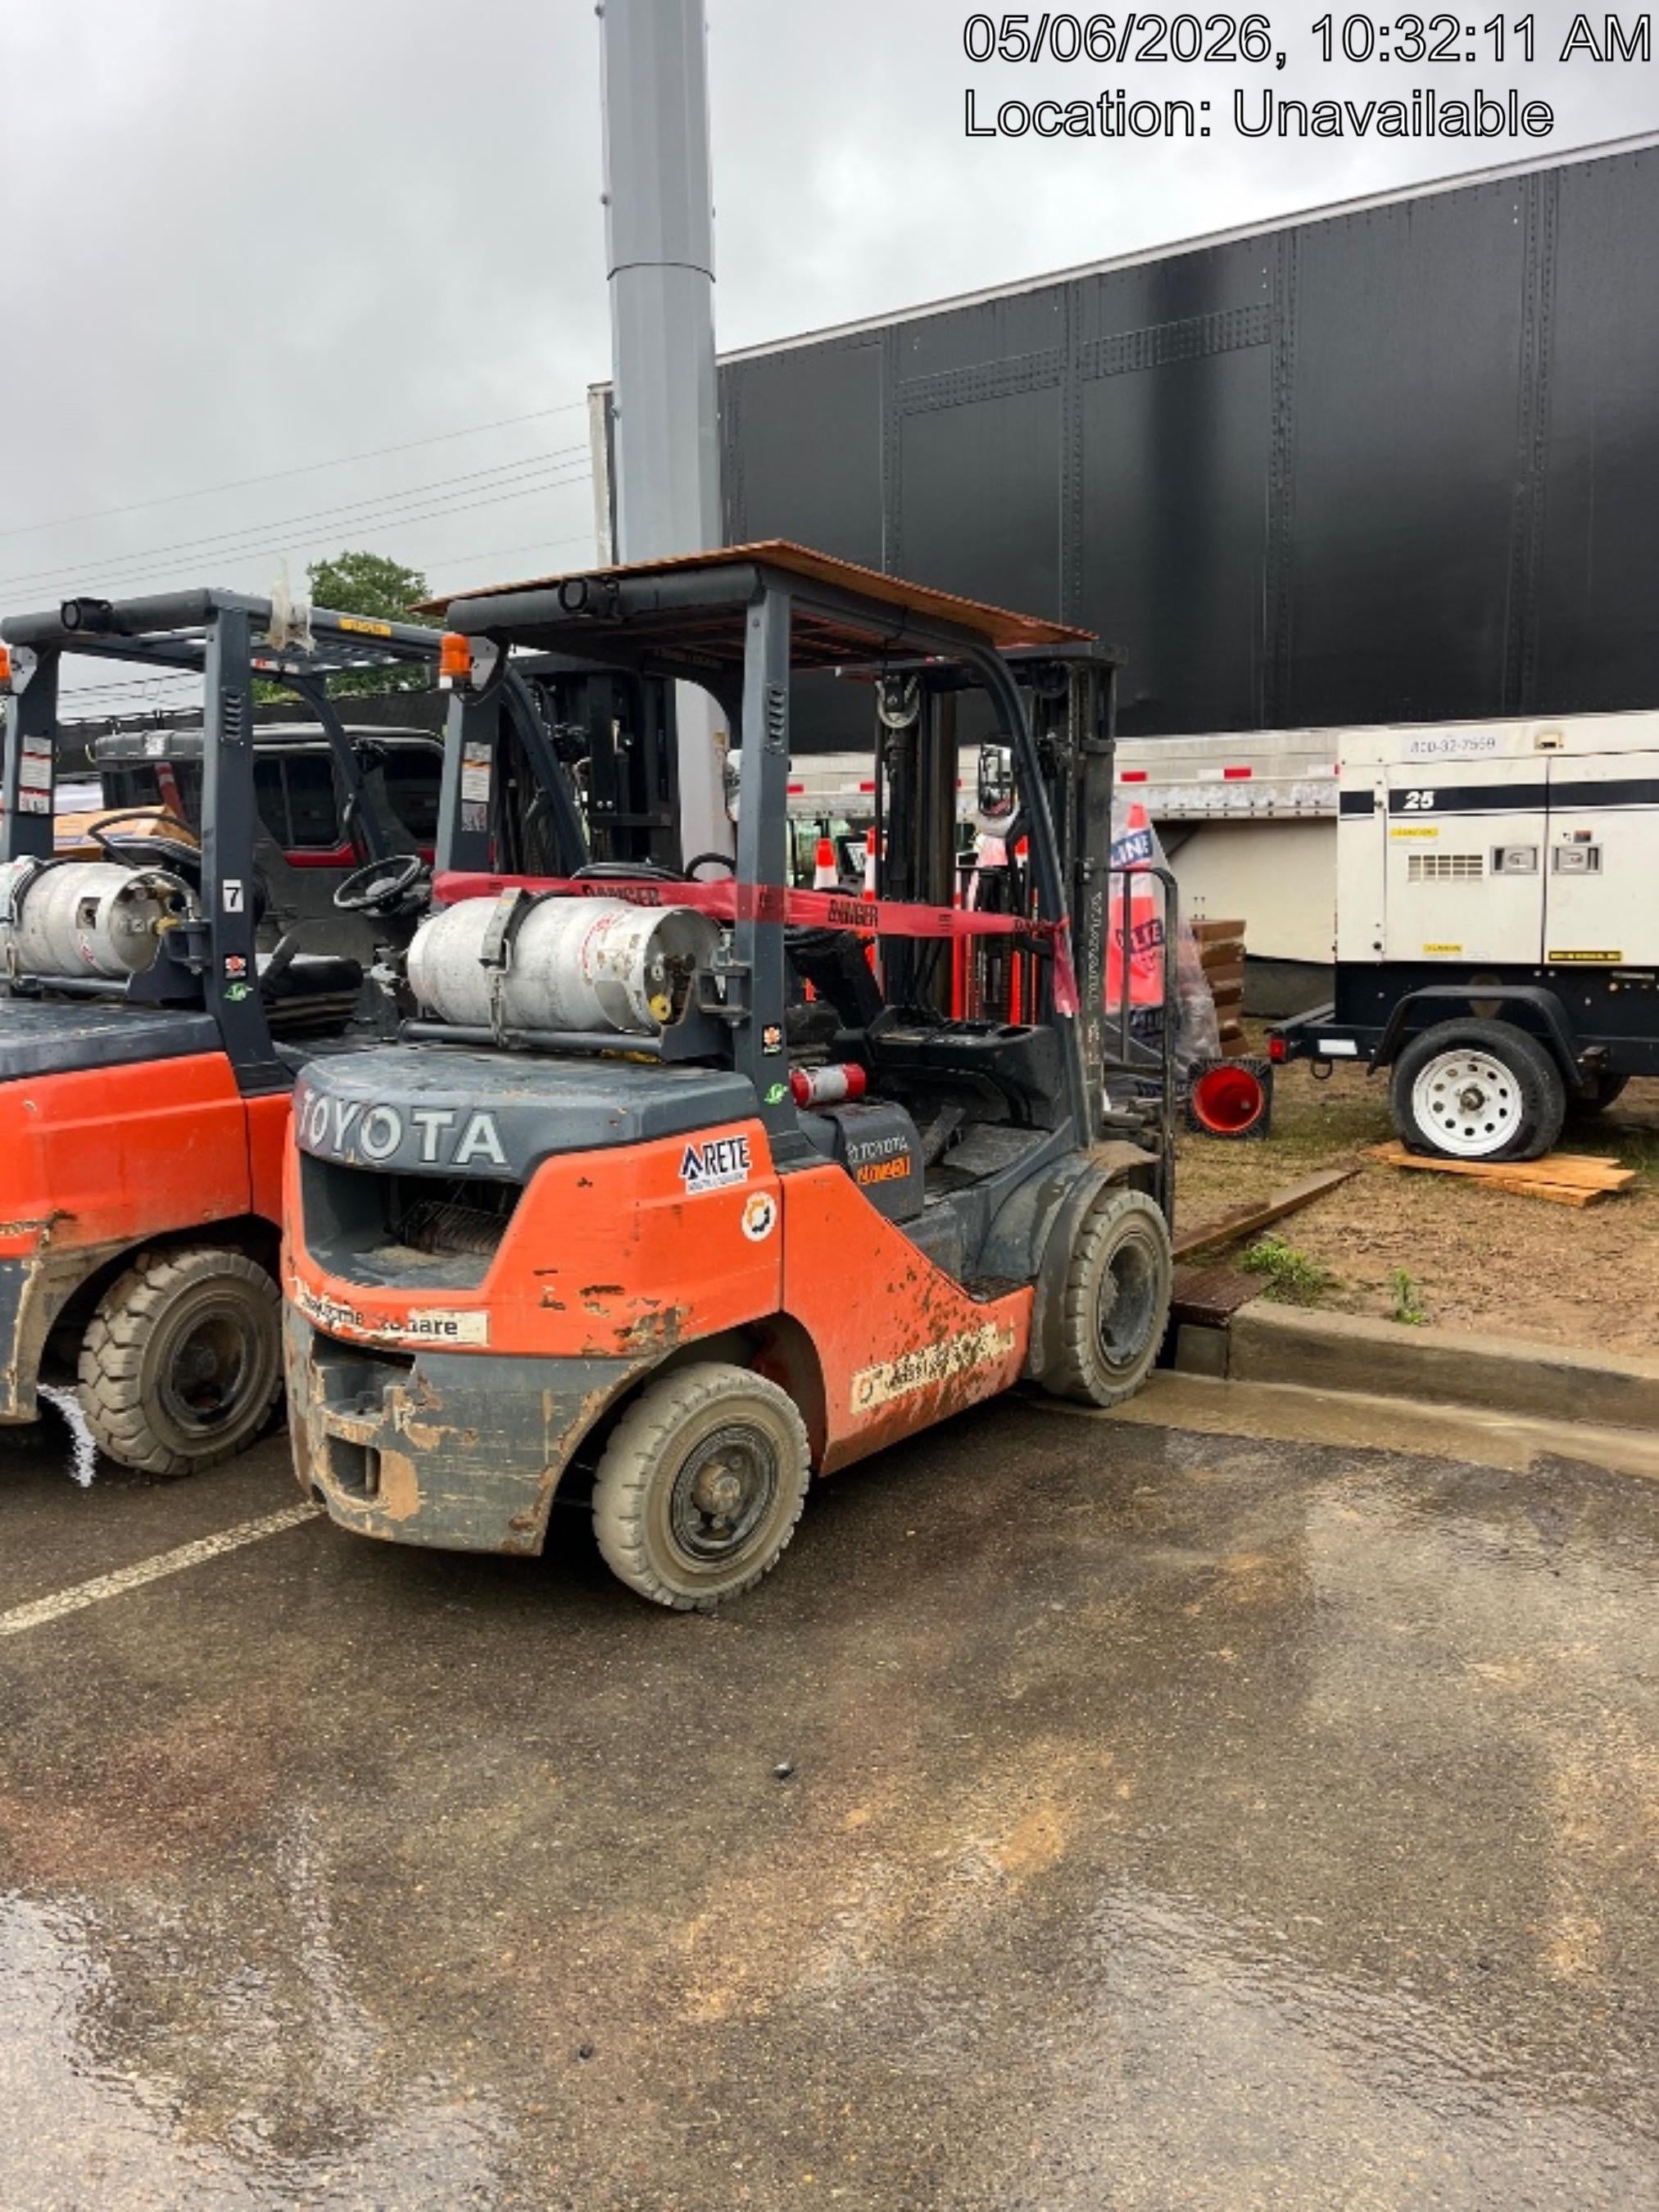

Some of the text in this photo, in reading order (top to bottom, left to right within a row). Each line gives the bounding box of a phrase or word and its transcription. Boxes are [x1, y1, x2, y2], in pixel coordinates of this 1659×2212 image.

[1403, 790, 1435, 809] 25
[225, 886, 238, 907] 7
[828, 900, 878, 927] DANGER
[298, 1088, 506, 1163] TOYOTA
